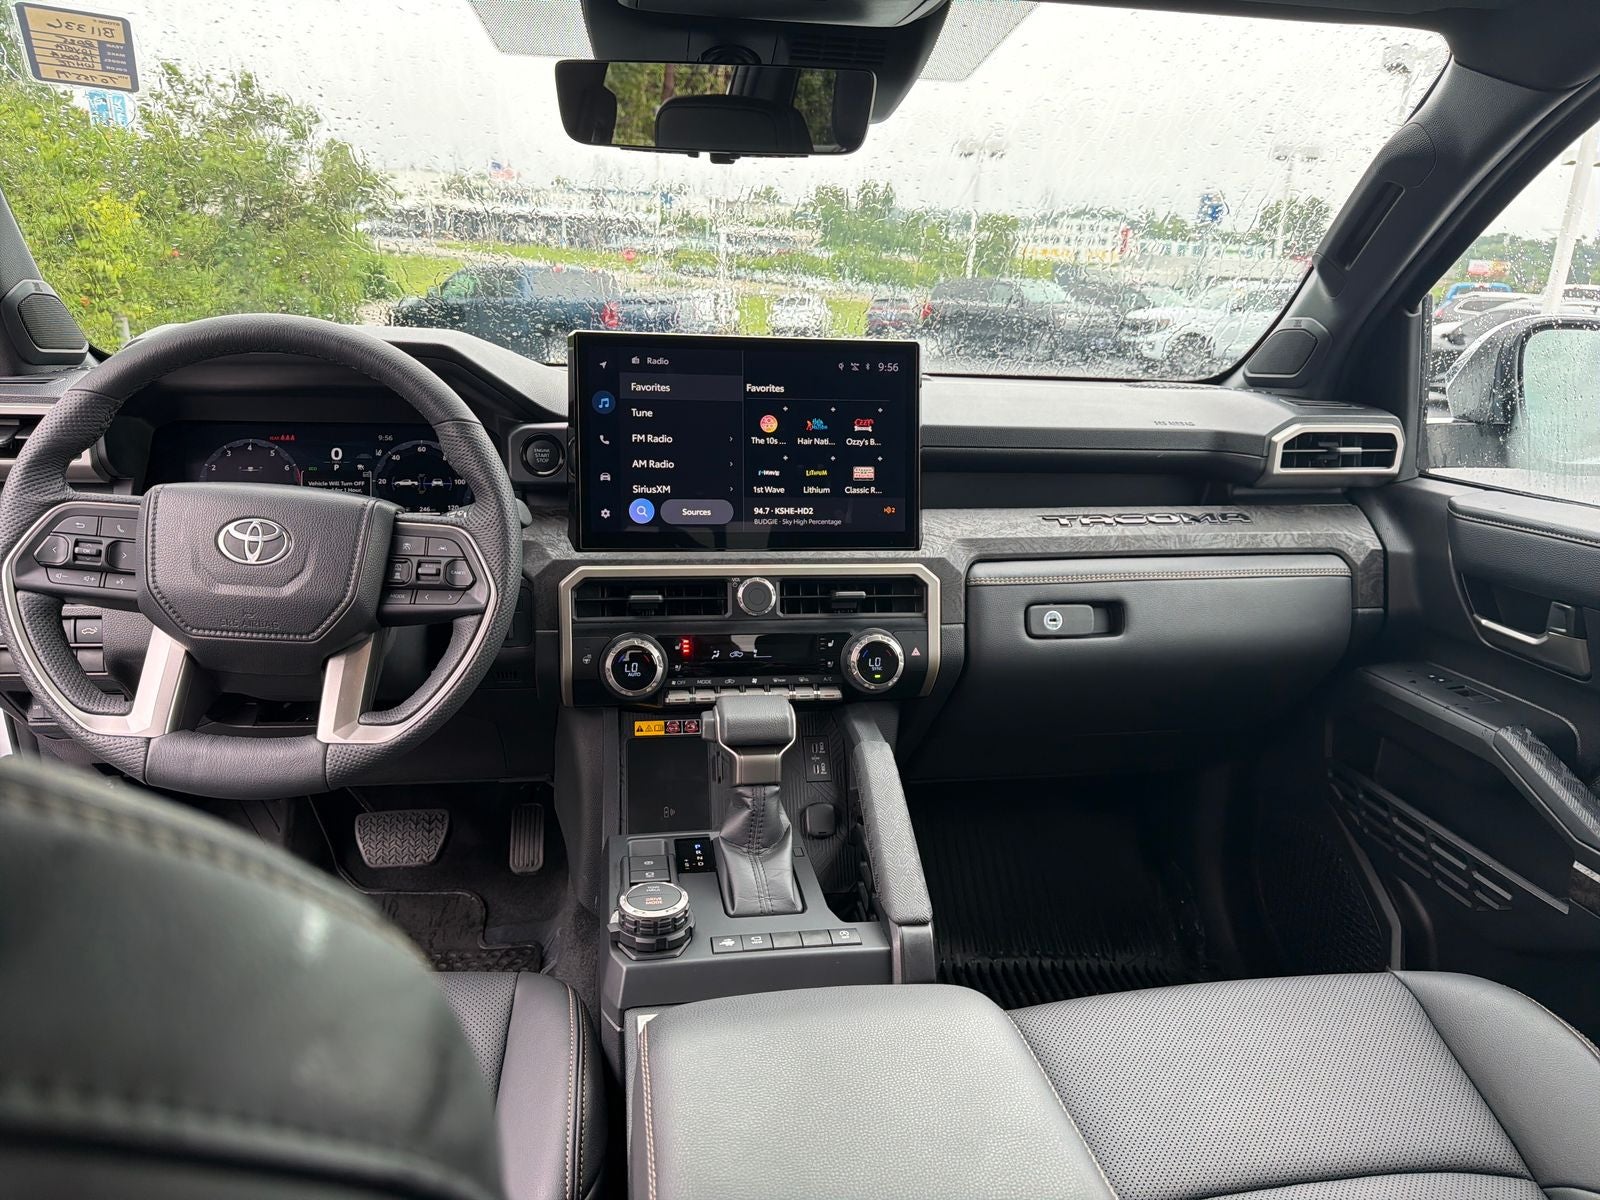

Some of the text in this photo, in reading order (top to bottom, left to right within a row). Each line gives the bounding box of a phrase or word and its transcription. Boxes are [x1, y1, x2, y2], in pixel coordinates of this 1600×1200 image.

[646, 357, 670, 365] Radio
[878, 362, 899, 372] 9:56
[631, 382, 670, 392] Favorites
[746, 384, 784, 392] Favorites
[631, 408, 653, 418] Tune
[632, 434, 673, 443] FM Radio
[750, 436, 765, 444] The
[846, 438, 869, 447] Ozzy's
[330, 448, 343, 461] 0
[632, 460, 674, 469] AM Radio
[632, 485, 671, 494] SiriusXM
[844, 486, 869, 494] Classic
[682, 508, 711, 516] Sources
[1037, 512, 1251, 528] TACOMA
[868, 657, 881, 667] LO
[624, 662, 639, 673] LO
